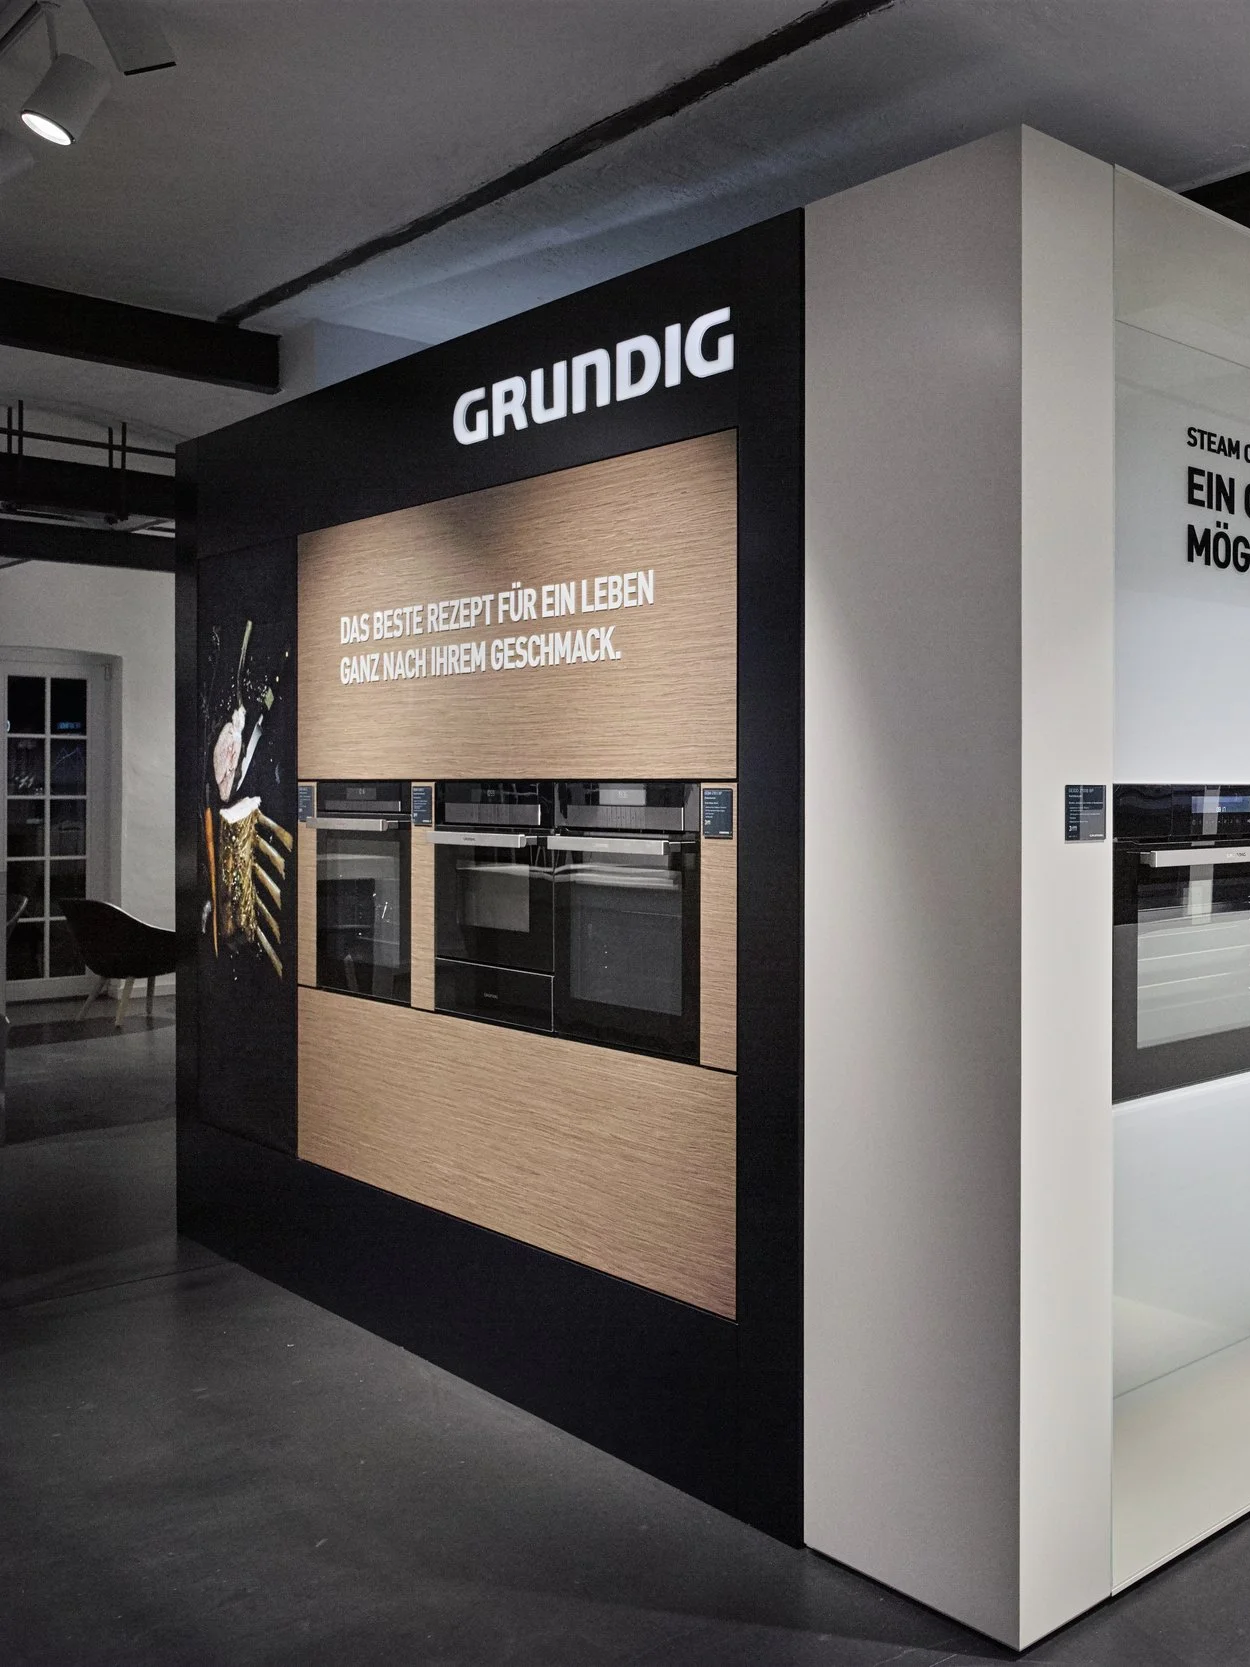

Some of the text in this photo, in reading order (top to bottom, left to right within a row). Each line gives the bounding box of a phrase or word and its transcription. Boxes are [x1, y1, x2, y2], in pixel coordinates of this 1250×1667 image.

[453, 306, 735, 446] GRUNDIG
[1186, 426, 1240, 460] STEAM
[1187, 465, 1235, 515] EIN
[340, 569, 654, 645] DAS BESTE REZEPT FÜR EIN LEBEN
[340, 625, 622, 685] GANZ NACH IHREM GESCHMACK.
